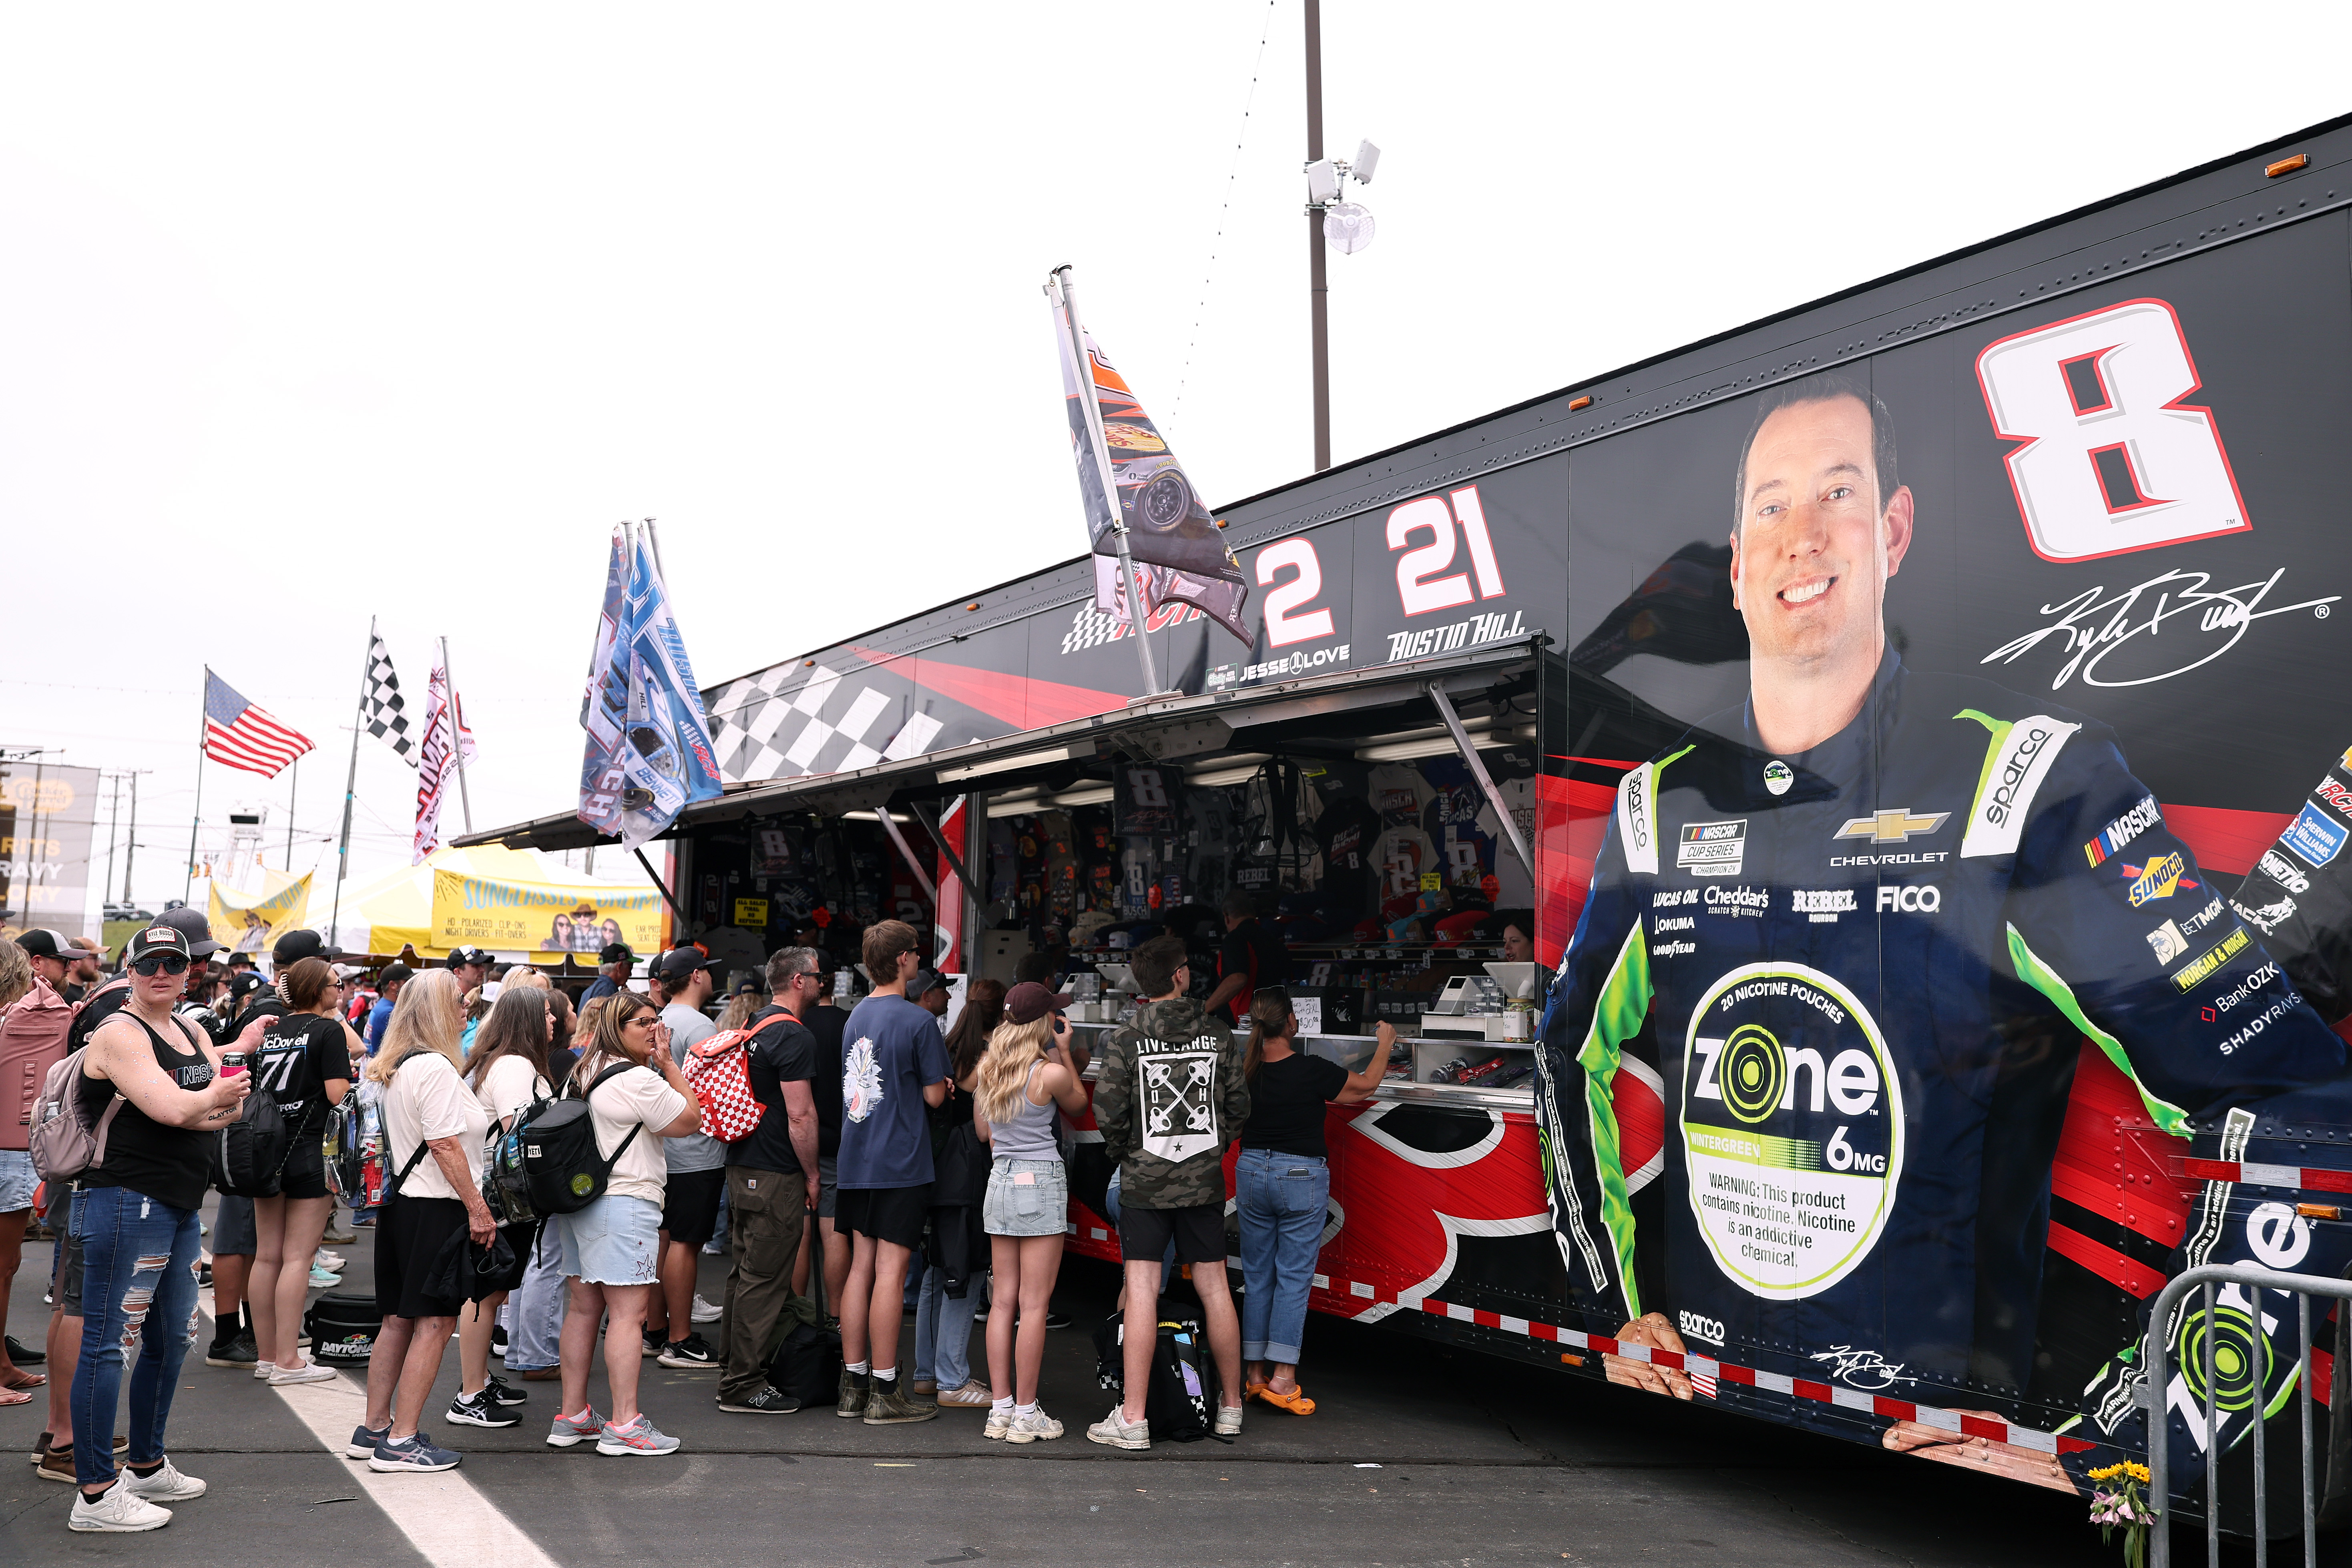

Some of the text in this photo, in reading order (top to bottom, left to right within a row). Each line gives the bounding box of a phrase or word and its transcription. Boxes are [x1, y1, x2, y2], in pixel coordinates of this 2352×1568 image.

[1975, 297, 2254, 564] 8
[1386, 484, 1506, 617] 21
[1256, 537, 1336, 648] 2
[1387, 610, 1525, 663] AUSTIN HILL
[1239, 644, 1350, 682] JESSE LOVE
[635, 767, 680, 805] BENNETT
[1766, 769, 1789, 777] zone
[1986, 729, 2047, 825] sparco
[1127, 769, 1169, 807] 8
[1628, 772, 1647, 847] sparco
[1702, 824, 1738, 839] NASCAR
[2108, 799, 2159, 852] NASCAR
[2302, 817, 2337, 847] SHERWIN
[761, 830, 789, 856] 8
[1095, 835, 1106, 848] 3
[1687, 844, 1735, 857] CUP SERIES
[1065, 865, 1074, 879] 3
[1348, 851, 1359, 869] 8
[1696, 865, 1737, 874] CHAMPION 2X
[1830, 852, 1949, 867] CHEVROLET
[1127, 864, 1145, 896] 8
[1237, 867, 1271, 884] REBEL
[2132, 854, 2183, 903] SUNOCO
[463, 879, 578, 910] SUNGLASSES
[1653, 885, 1769, 908] LUCAS OIL Cheddar's
[1792, 885, 1940, 912] REBEL FICO
[1123, 904, 1147, 916] BUSCH
[1741, 908, 1763, 918] KITCHEN
[1809, 913, 1838, 923] BOURBON
[2179, 897, 2224, 936] BETMGM
[445, 927, 526, 939] NIGHT DRIVERS FIT-OVERS
[448, 918, 525, 930] HD POLARIZED CLIP-ONS
[635, 925, 645, 933] EAR
[1659, 917, 1695, 931] OKUMA
[637, 934, 650, 942] SEAT
[1653, 940, 1696, 958] GOODYEAR
[2176, 930, 2249, 990] MORGAN & MORGAN
[1310, 963, 1330, 986] 8
[1721, 981, 1845, 1025] 20 NICOTINE POUCHES
[1136, 1036, 1218, 1055] LIVE LARGE
[261, 1051, 301, 1092] 71
[1694, 1024, 1879, 1123] zone
[1198, 1088, 1207, 1102] H
[208, 1106, 237, 1121] CLAYTON
[1689, 1131, 1760, 1160] WINTERGREEN
[1548, 1099, 1557, 1125] product
[1554, 1126, 1562, 1155] contains
[1560, 1155, 1568, 1186] nicotine.
[1575, 1225, 1591, 1254] addictive
[1589, 1254, 1601, 1283] chemical.
[1709, 1172, 1846, 1211] WARNING: This product
[1702, 1193, 1856, 1233] contains nicotine. Nicotine
[2210, 1213, 2217, 1224] an
[1728, 1216, 1813, 1250] is an addictive
[1741, 1242, 1798, 1268] chemical.
[1679, 1309, 1725, 1341] sparco
[321, 1341, 372, 1354] DAYTONA
